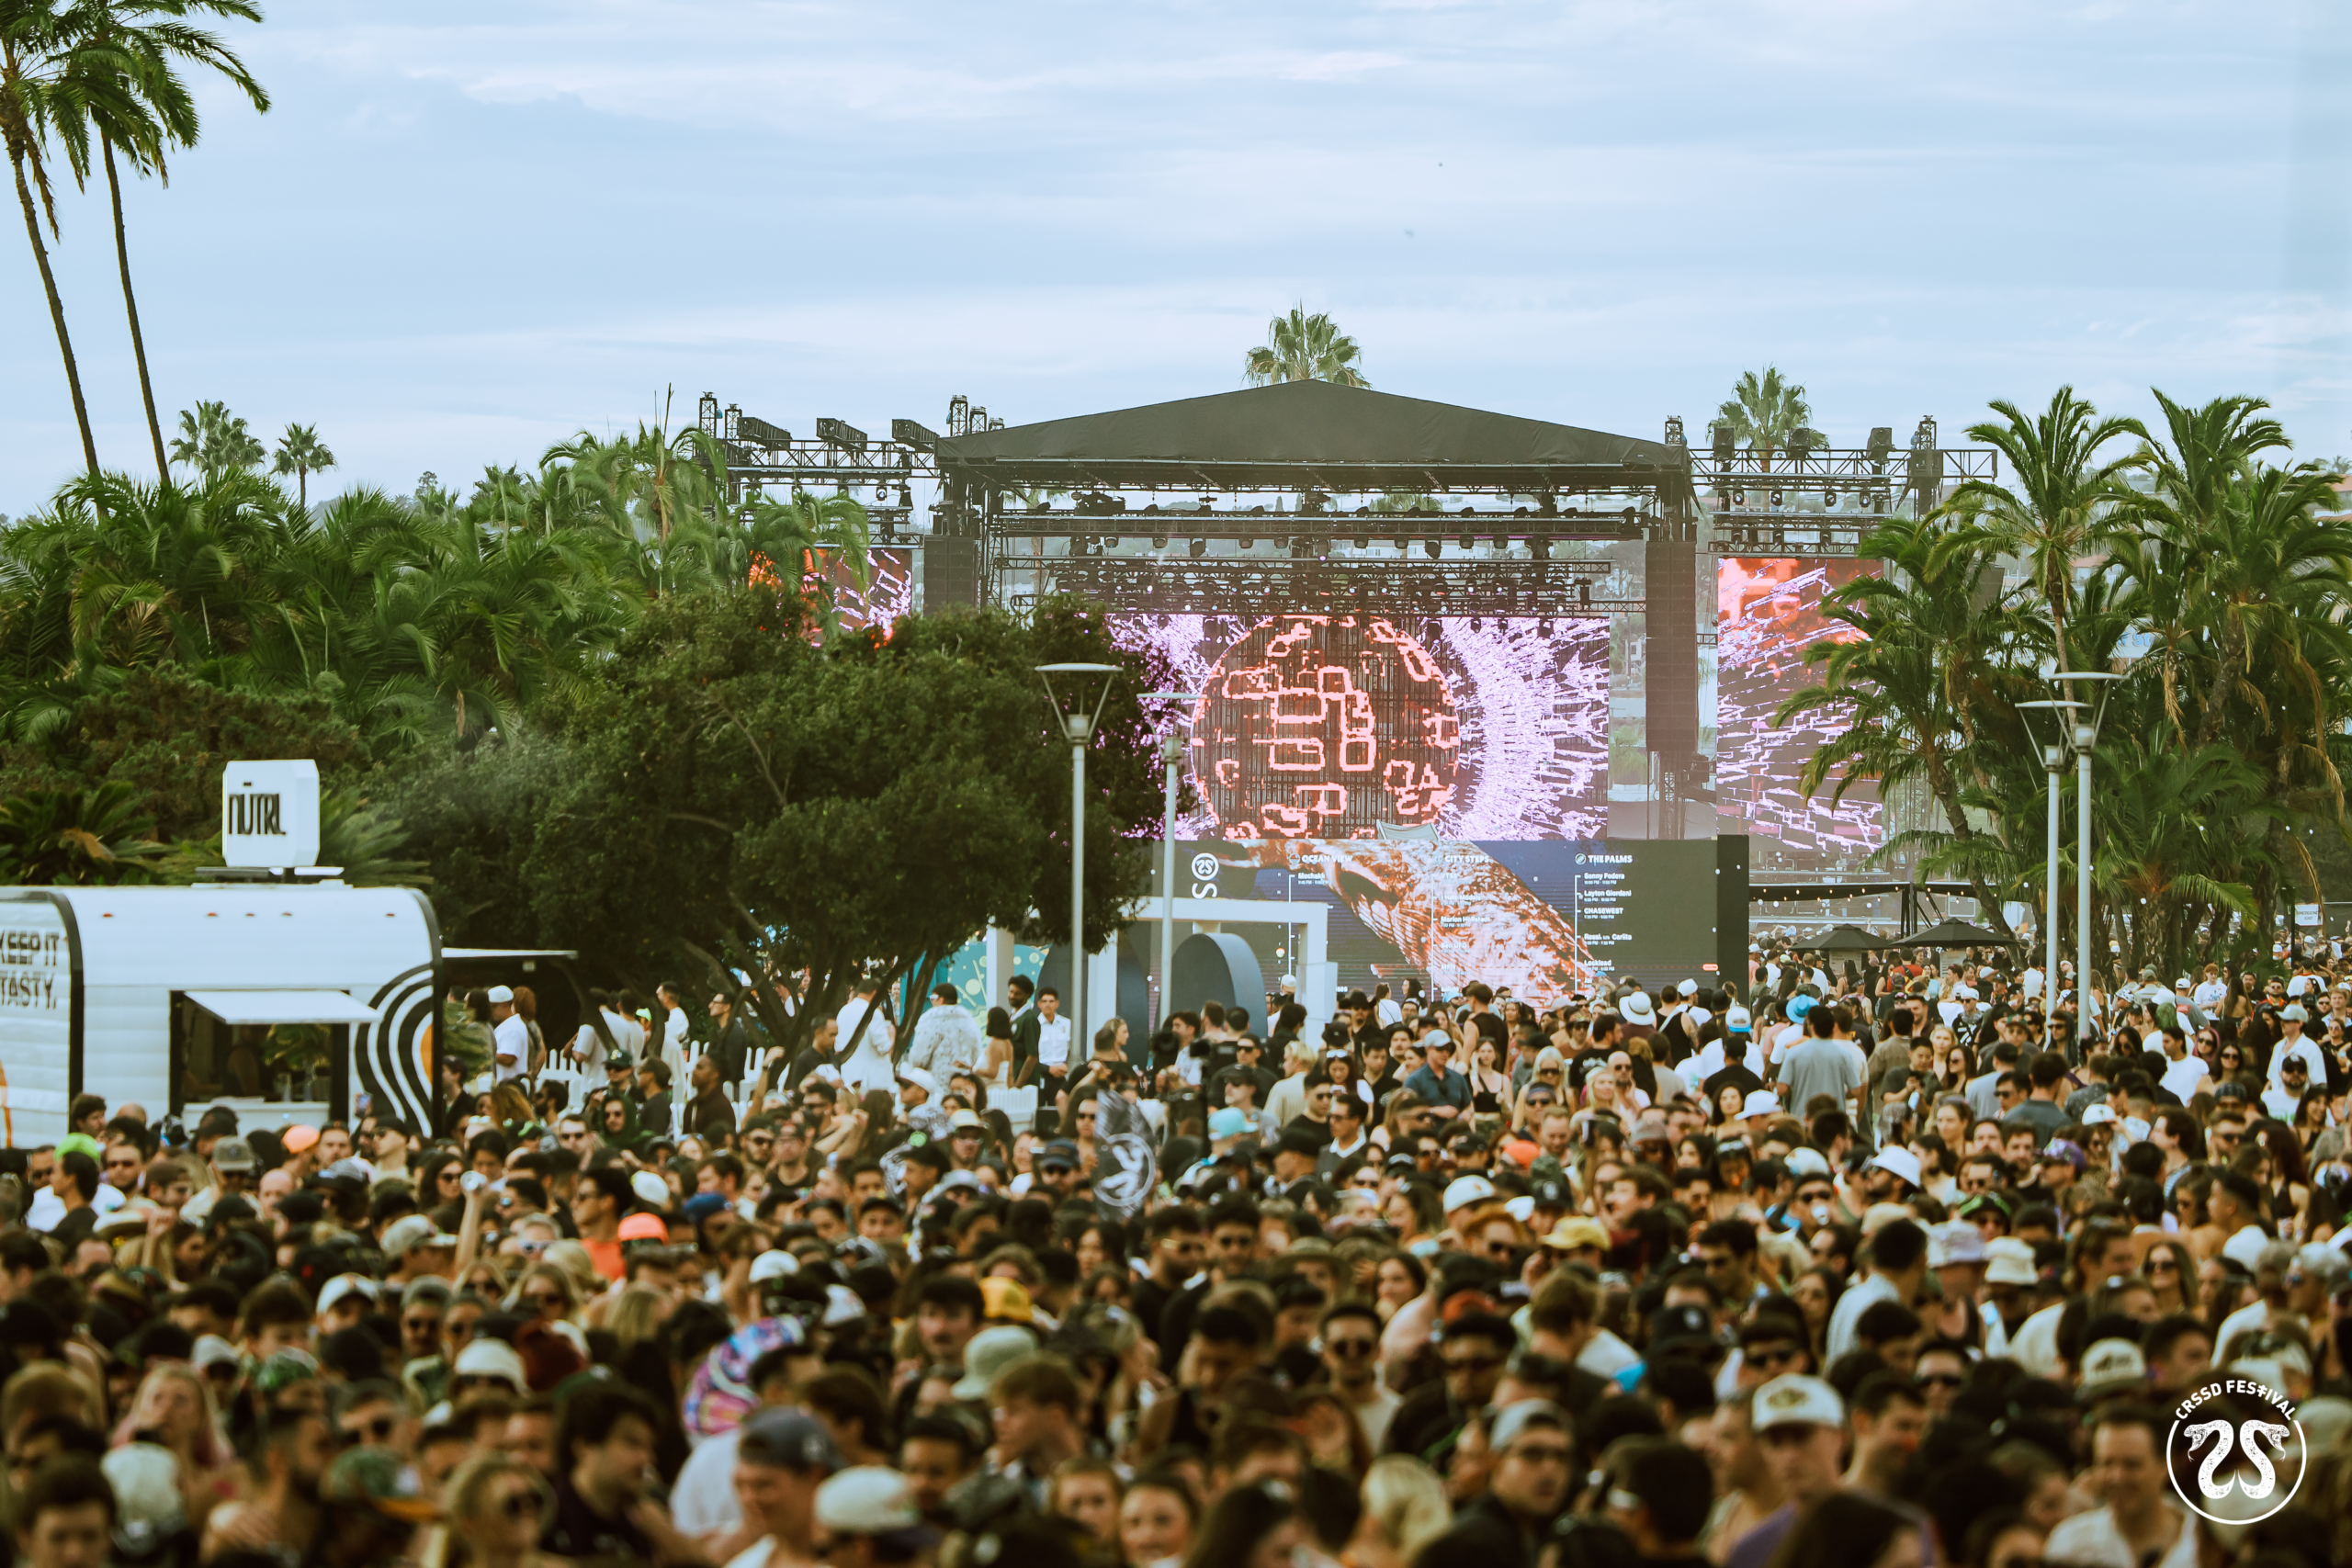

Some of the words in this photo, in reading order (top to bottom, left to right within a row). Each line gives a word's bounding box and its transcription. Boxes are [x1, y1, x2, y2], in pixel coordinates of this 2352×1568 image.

[1588, 855, 1604, 863] THE
[1605, 855, 1634, 863] PALMS
[1584, 872, 1603, 880] Sonny
[1584, 889, 1605, 897] Layton
[44, 931, 60, 966] IT
